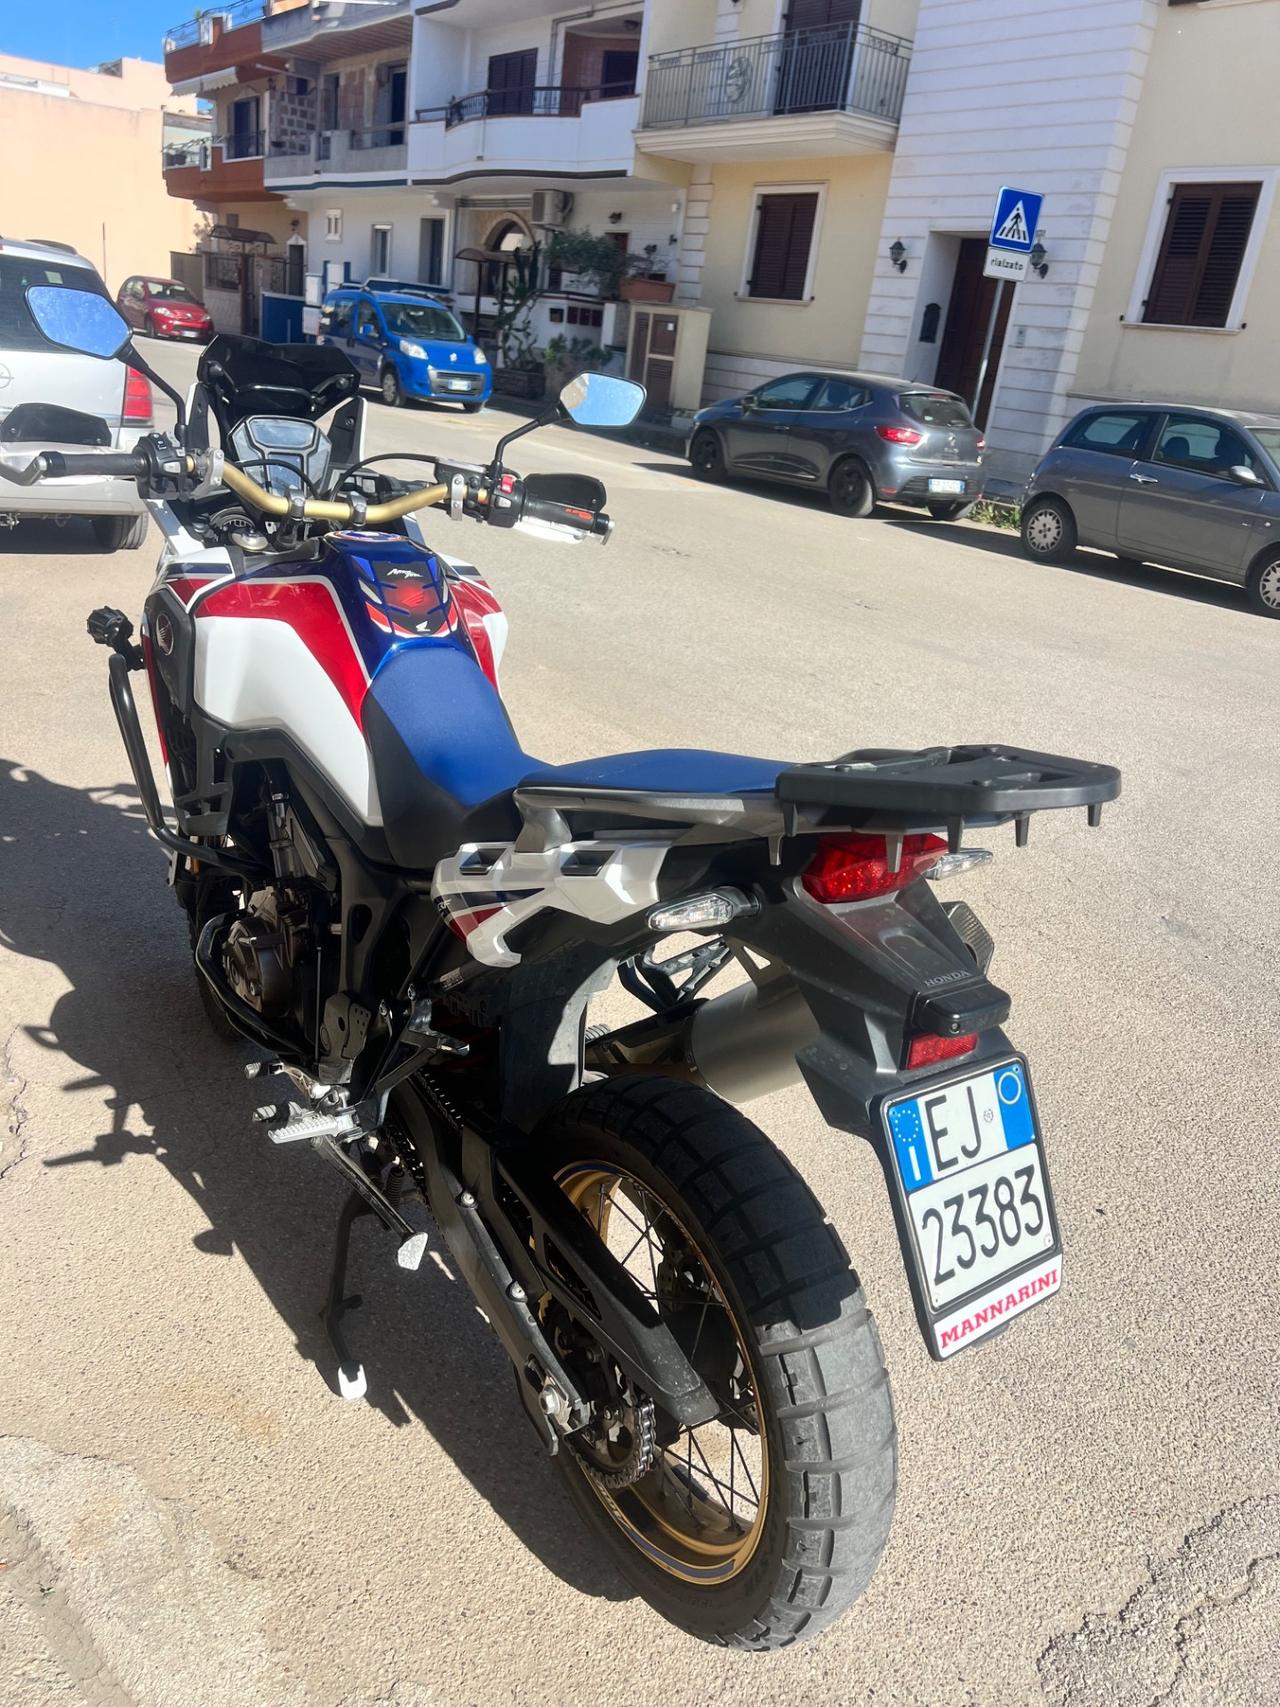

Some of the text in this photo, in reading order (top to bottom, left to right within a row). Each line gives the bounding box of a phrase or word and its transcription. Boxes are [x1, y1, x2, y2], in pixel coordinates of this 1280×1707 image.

[990, 258, 1024, 271] rialzato
[924, 970, 972, 987] HONDA
[924, 1086, 983, 1172] EJ
[921, 1165, 1045, 1286] 23383
[940, 1268, 1059, 1349] MANNARINI
